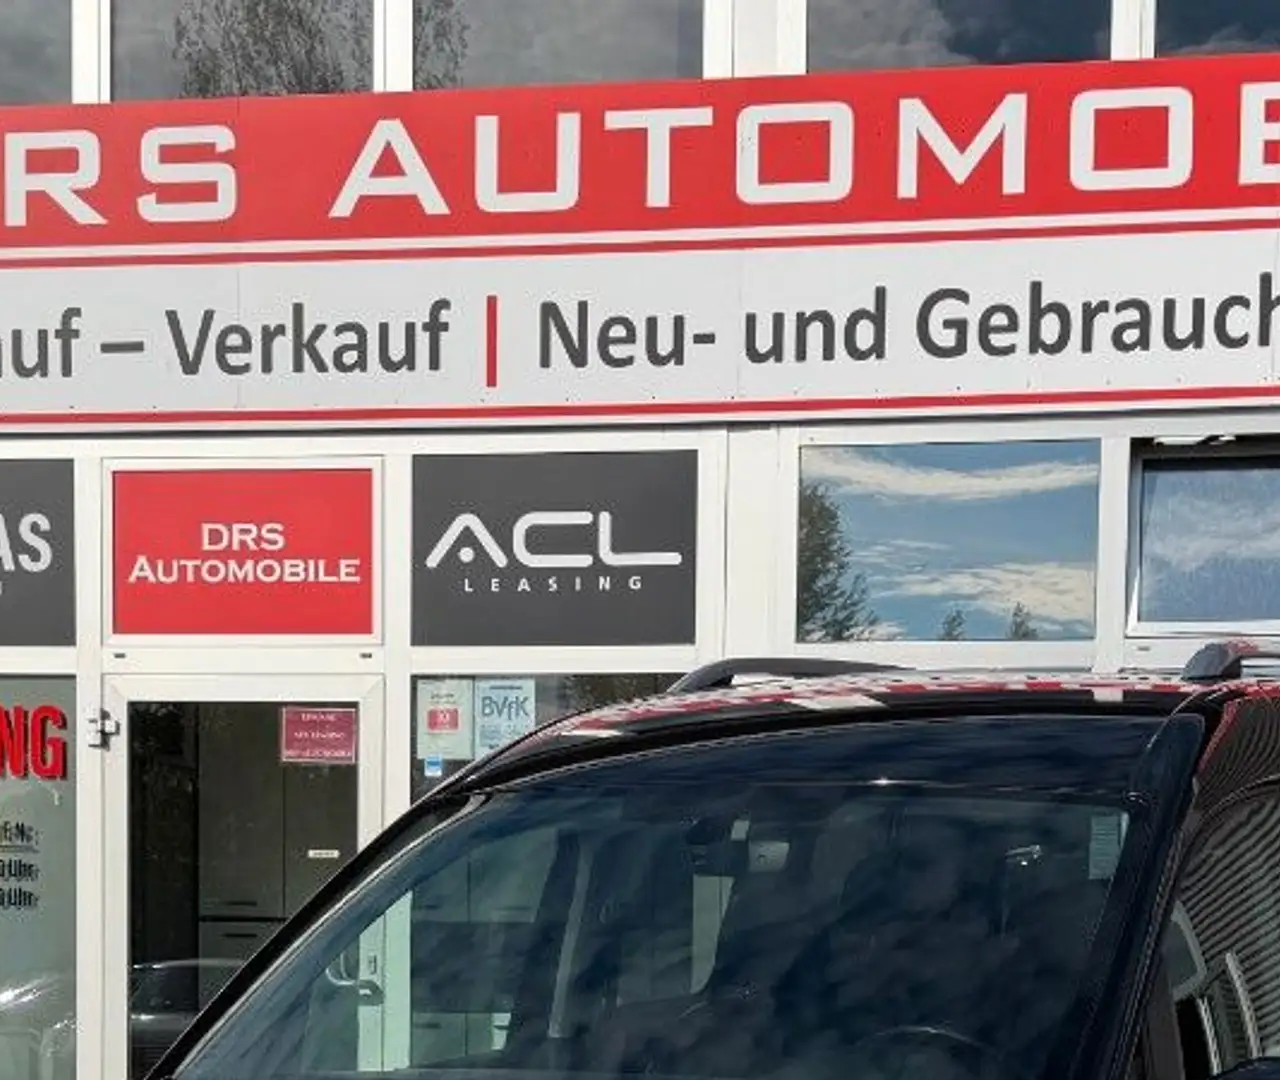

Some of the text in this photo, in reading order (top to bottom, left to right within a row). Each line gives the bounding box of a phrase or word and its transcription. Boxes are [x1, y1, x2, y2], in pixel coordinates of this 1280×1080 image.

[165, 298, 451, 377] Verkauf
[539, 300, 717, 370] Neu-
[745, 286, 887, 365] und
[201, 522, 285, 552] DRS
[425, 510, 683, 569] ACL
[129, 554, 361, 584] AUTOMOBILE
[464, 576, 642, 593] LEASING
[481, 695, 530, 720] BVfK
